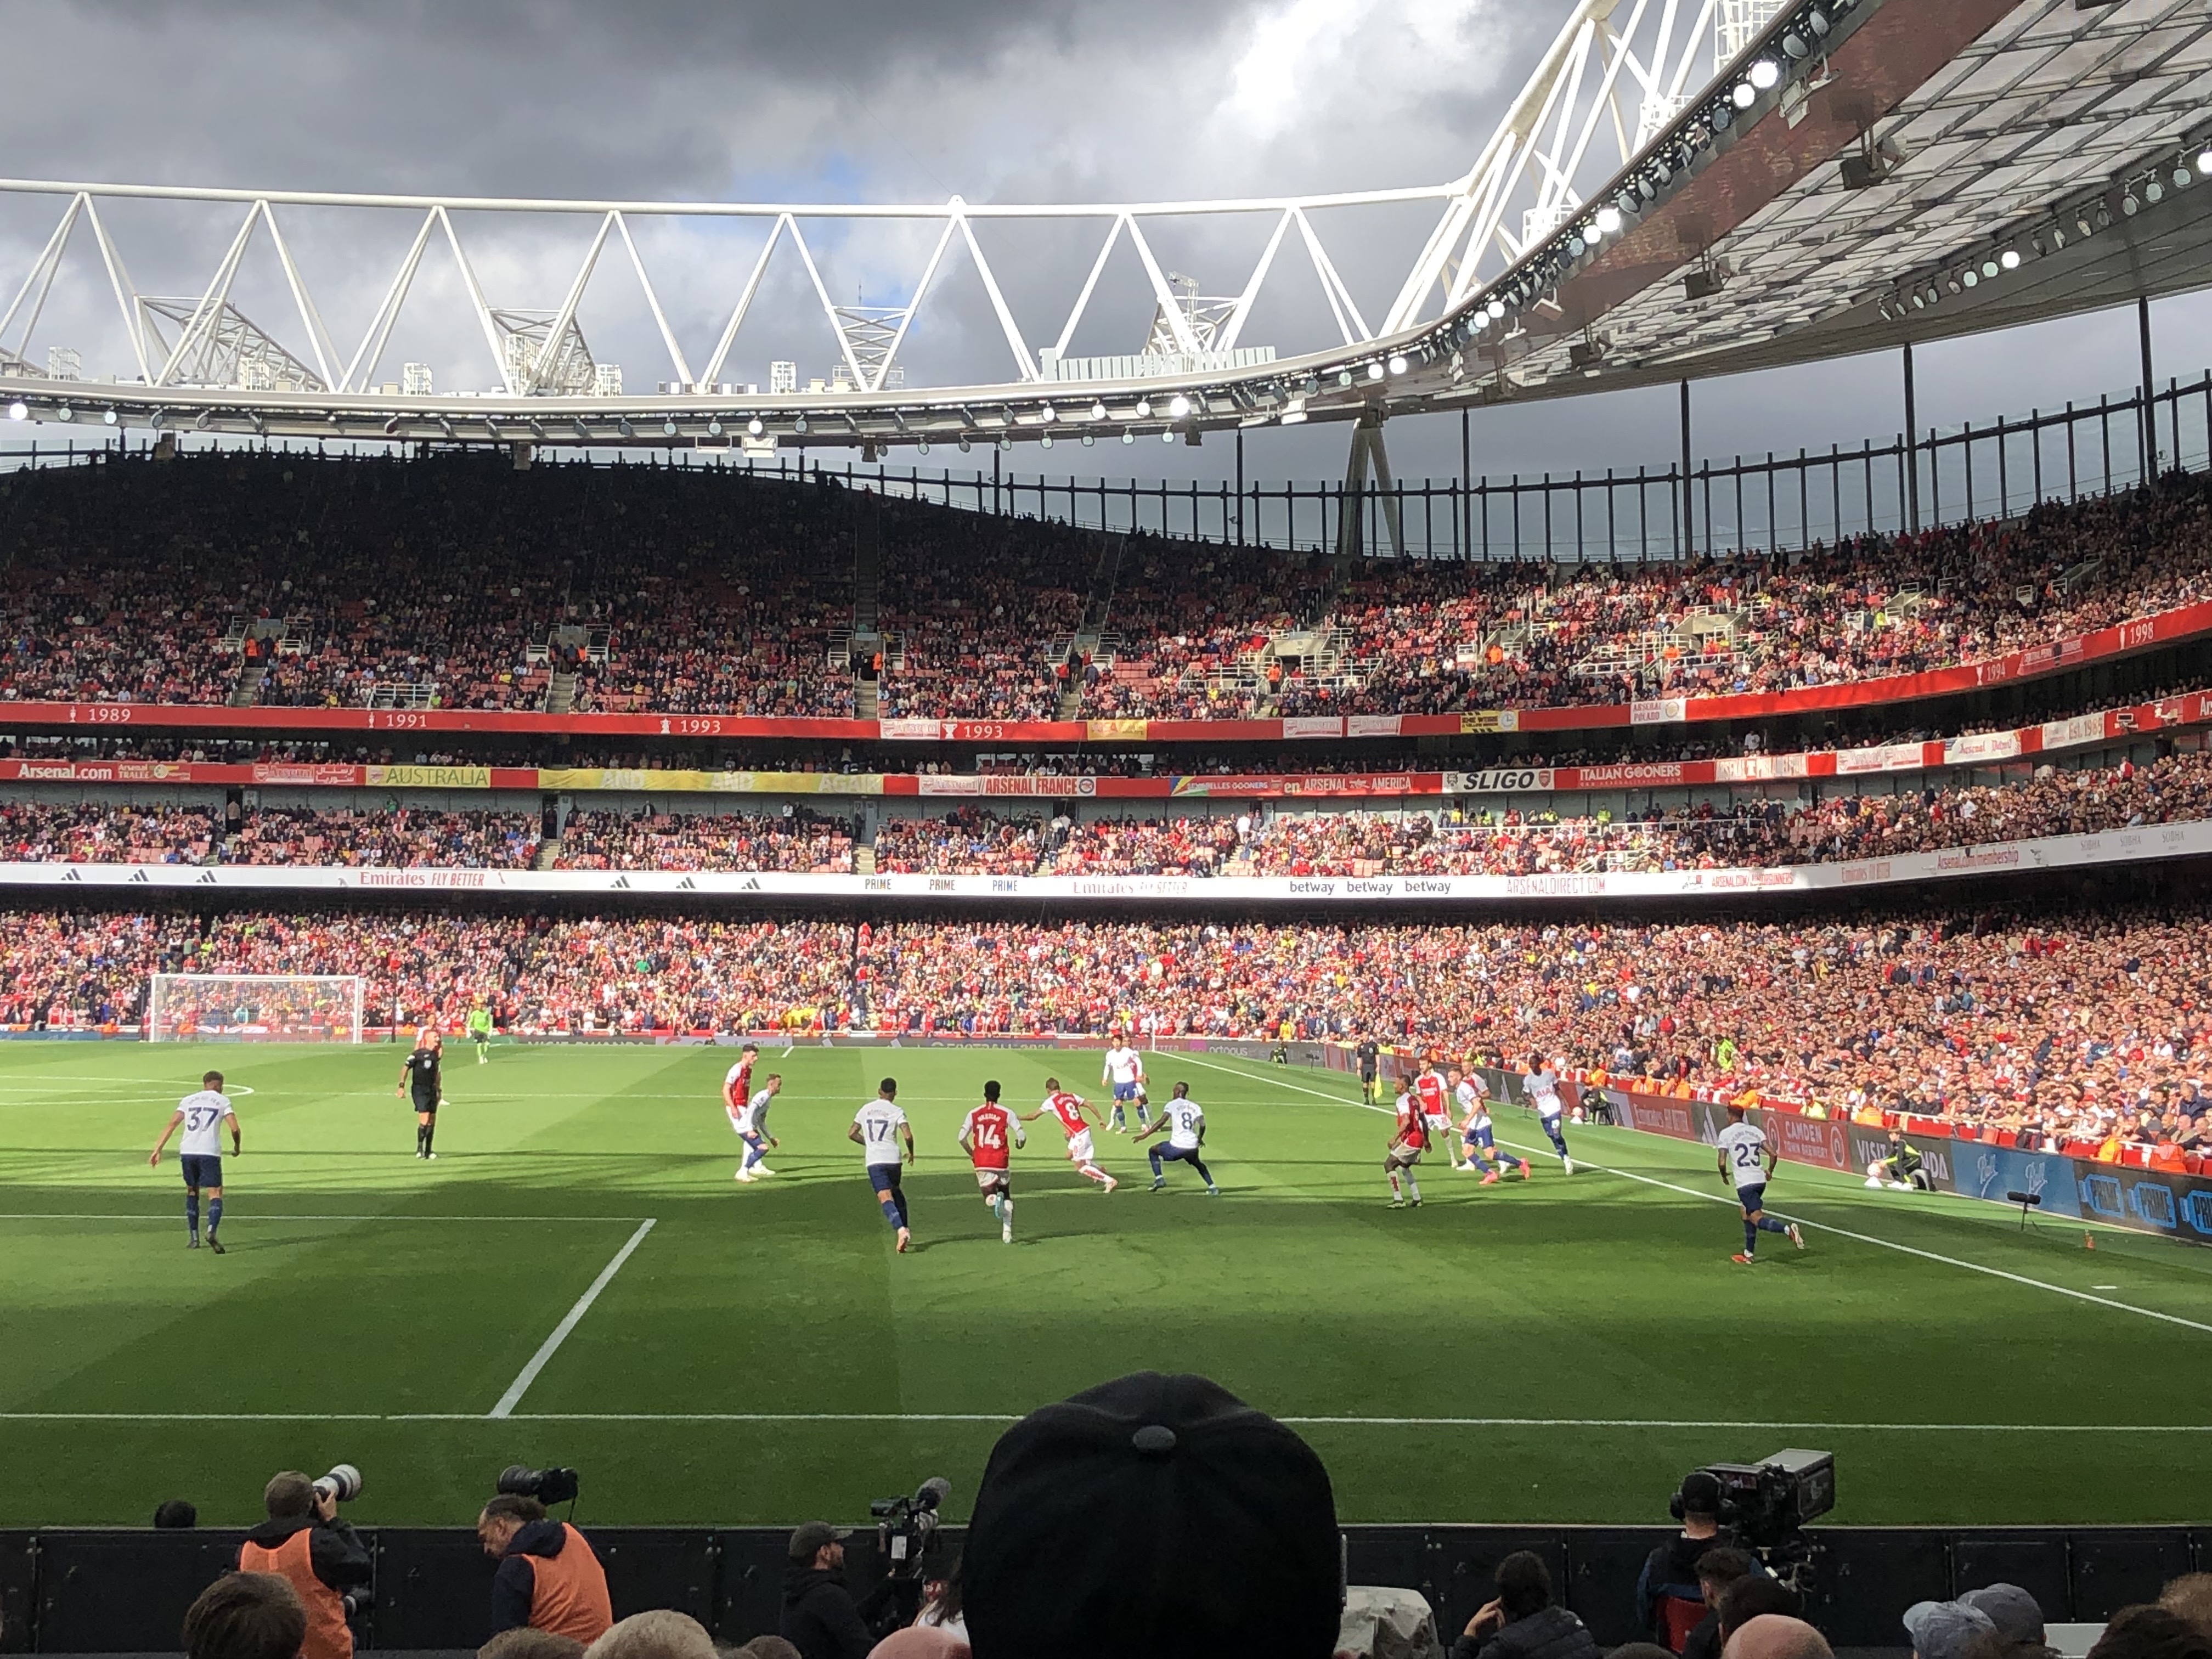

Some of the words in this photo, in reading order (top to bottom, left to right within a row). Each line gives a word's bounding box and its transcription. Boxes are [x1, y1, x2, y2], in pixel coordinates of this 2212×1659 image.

[2130, 622, 2153, 644] 1998
[1987, 662, 2006, 681] 1994
[88, 708, 131, 721] 1989
[386, 714, 427, 727] 1991
[680, 720, 721, 733] 1993
[964, 725, 1003, 738] 1993
[18, 763, 112, 780] Arsenal.com
[386, 768, 488, 785] AUSTRALIA
[1580, 768, 1622, 781] ITALIAN
[1624, 765, 1681, 778] GOONERS
[987, 778, 1033, 795] ARSENAL
[1036, 778, 1077, 795] FRANCE
[1304, 777, 1347, 791] ARSENAL
[1372, 776, 1412, 790] AMERICA
[1464, 771, 1534, 790] SLIGO
[360, 872, 425, 885] Emirates
[431, 872, 448, 885] FLY
[450, 872, 484, 887] BETTER
[865, 879, 891, 890] PRIME
[929, 879, 955, 891] PRIME
[992, 879, 1018, 891] PRIME
[1290, 881, 1335, 895] betway
[1347, 881, 1393, 895] betway
[1404, 880, 1451, 894] betway
[187, 1107, 219, 1132] 37
[1065, 1102, 1080, 1120] 8
[1181, 1112, 1193, 1130] 8
[866, 1119, 889, 1142] 17
[977, 1124, 1001, 1149] 14
[1785, 1120, 1822, 1143] CAMDEN
[1734, 1143, 1760, 1167] 23
[1857, 1139, 1886, 1164] VISIT
